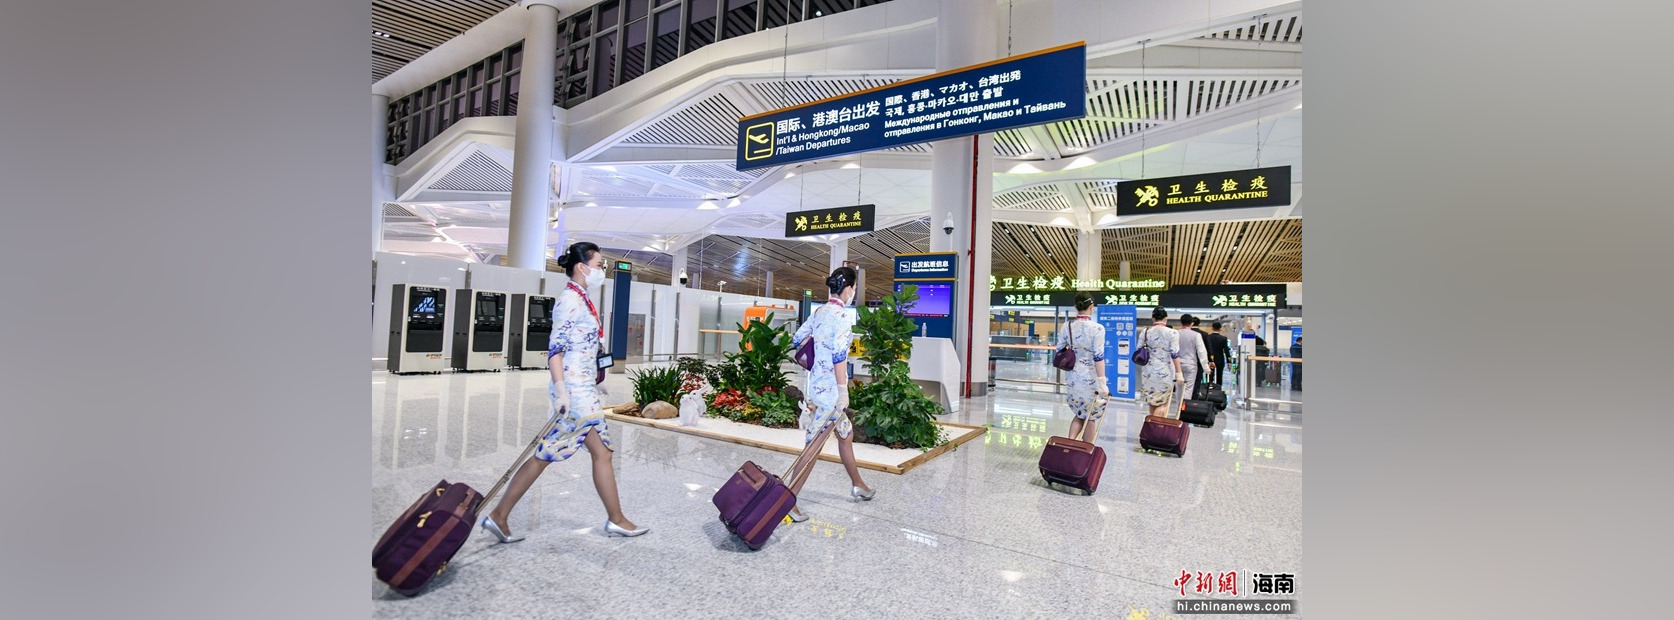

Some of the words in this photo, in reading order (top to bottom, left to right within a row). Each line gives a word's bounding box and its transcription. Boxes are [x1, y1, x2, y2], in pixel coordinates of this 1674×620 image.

[885, 106, 904, 118] 국제,
[982, 86, 1004, 100] 출발
[776, 100, 880, 135] 国际、港澳台出发
[884, 111, 950, 129] Международные
[952, 100, 1012, 117] отправления
[1012, 98, 1019, 106] и
[884, 122, 935, 138] отправления
[943, 114, 982, 128] Гонконг,
[984, 109, 1014, 122] Макао
[1016, 108, 1022, 116] и
[1024, 101, 1066, 114] Тайвань
[792, 134, 797, 143] &
[798, 122, 870, 141] Hongkong/Macao
[776, 145, 804, 156] /Taiwan
[806, 136, 851, 150] Departures
[1167, 176, 1268, 196] 卫生检疫
[1166, 196, 1202, 205] HEALTH
[1204, 190, 1268, 202] QUARANTINE
[810, 222, 829, 230] HEALTH
[830, 220, 862, 229] QUARANTINE
[811, 210, 862, 224] 卫生检疫
[1000, 276, 1066, 290] 卫生检疫
[1071, 278, 1104, 288] Health
[1106, 278, 1166, 290] Quarantine
